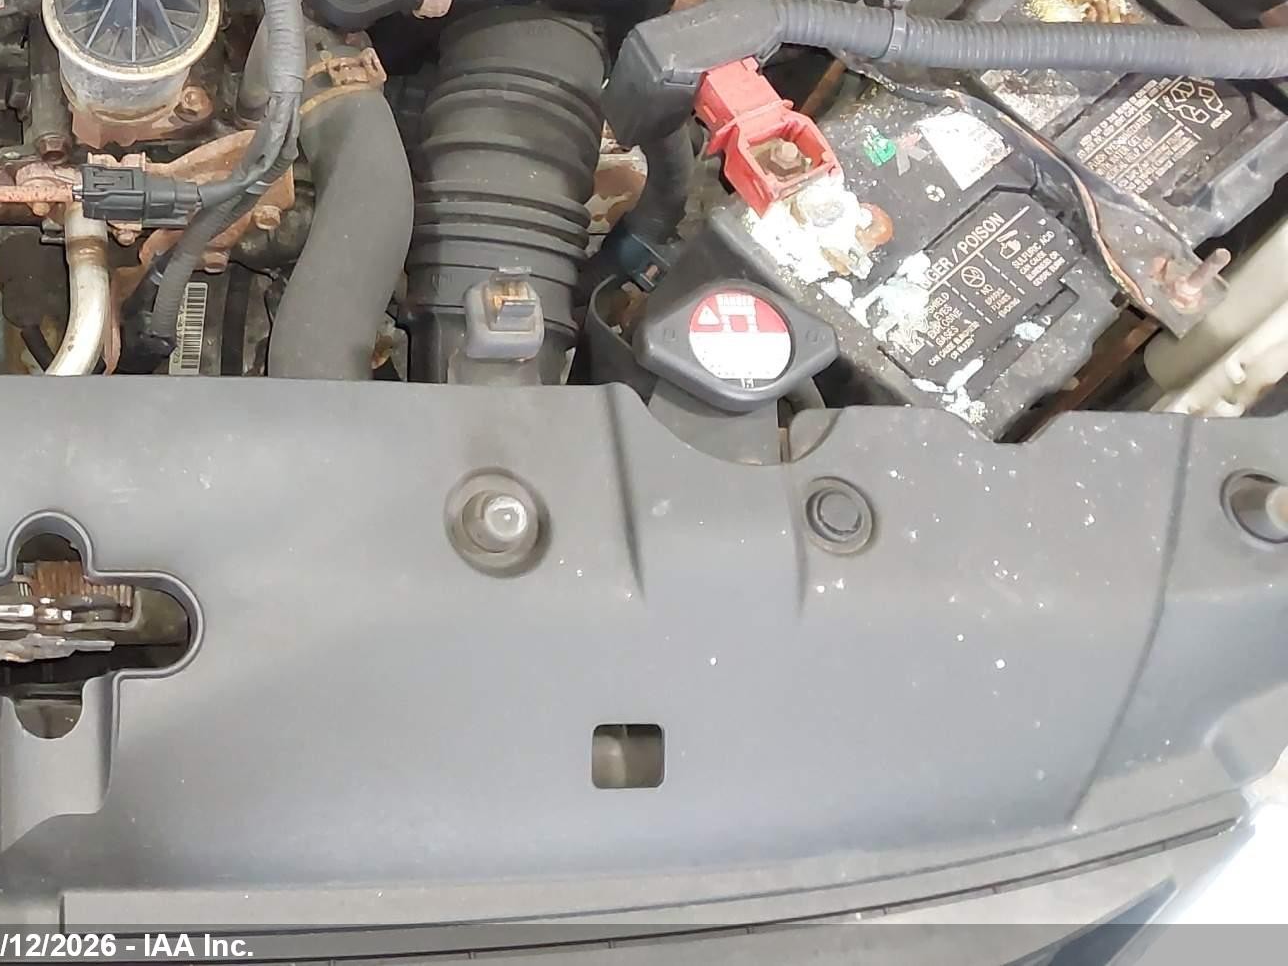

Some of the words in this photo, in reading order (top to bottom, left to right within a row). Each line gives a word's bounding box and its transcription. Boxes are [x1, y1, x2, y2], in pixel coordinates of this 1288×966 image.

[957, 212, 1005, 255] POISON
[927, 307, 963, 339] EXPLOSIVE
[933, 303, 953, 322] EYES
[935, 325, 959, 347] GASES
